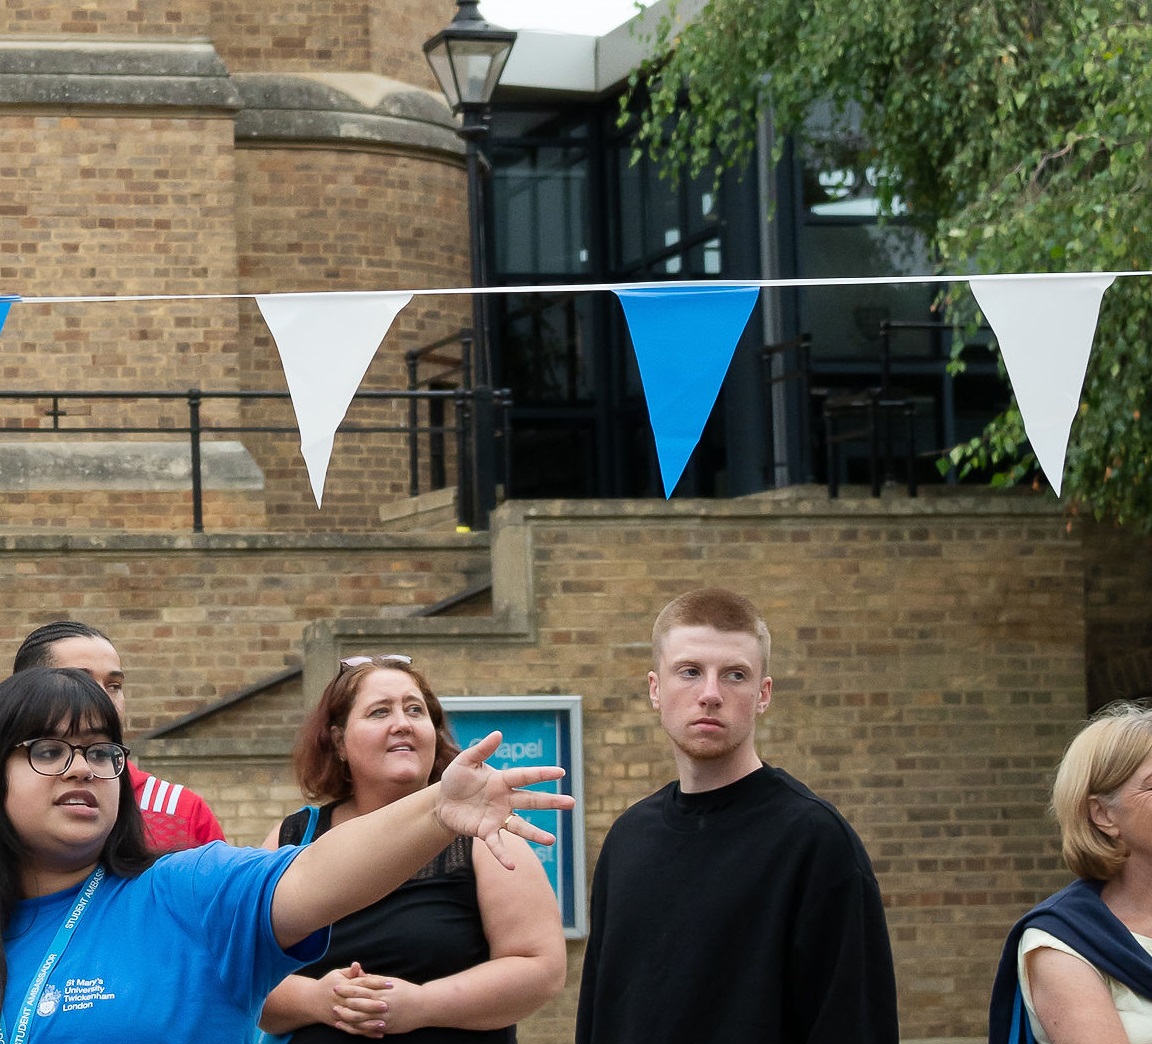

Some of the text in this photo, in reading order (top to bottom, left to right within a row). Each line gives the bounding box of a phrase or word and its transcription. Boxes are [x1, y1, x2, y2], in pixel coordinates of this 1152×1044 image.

[470, 738, 543, 762] apel
[65, 897, 89, 929] STUDENT
[26, 953, 58, 1007] AMBASSADOR
[66, 978, 104, 987] St Mary's
[64, 985, 106, 994] University
[64, 993, 115, 1002] Twickenham
[62, 1001, 93, 1012] London
